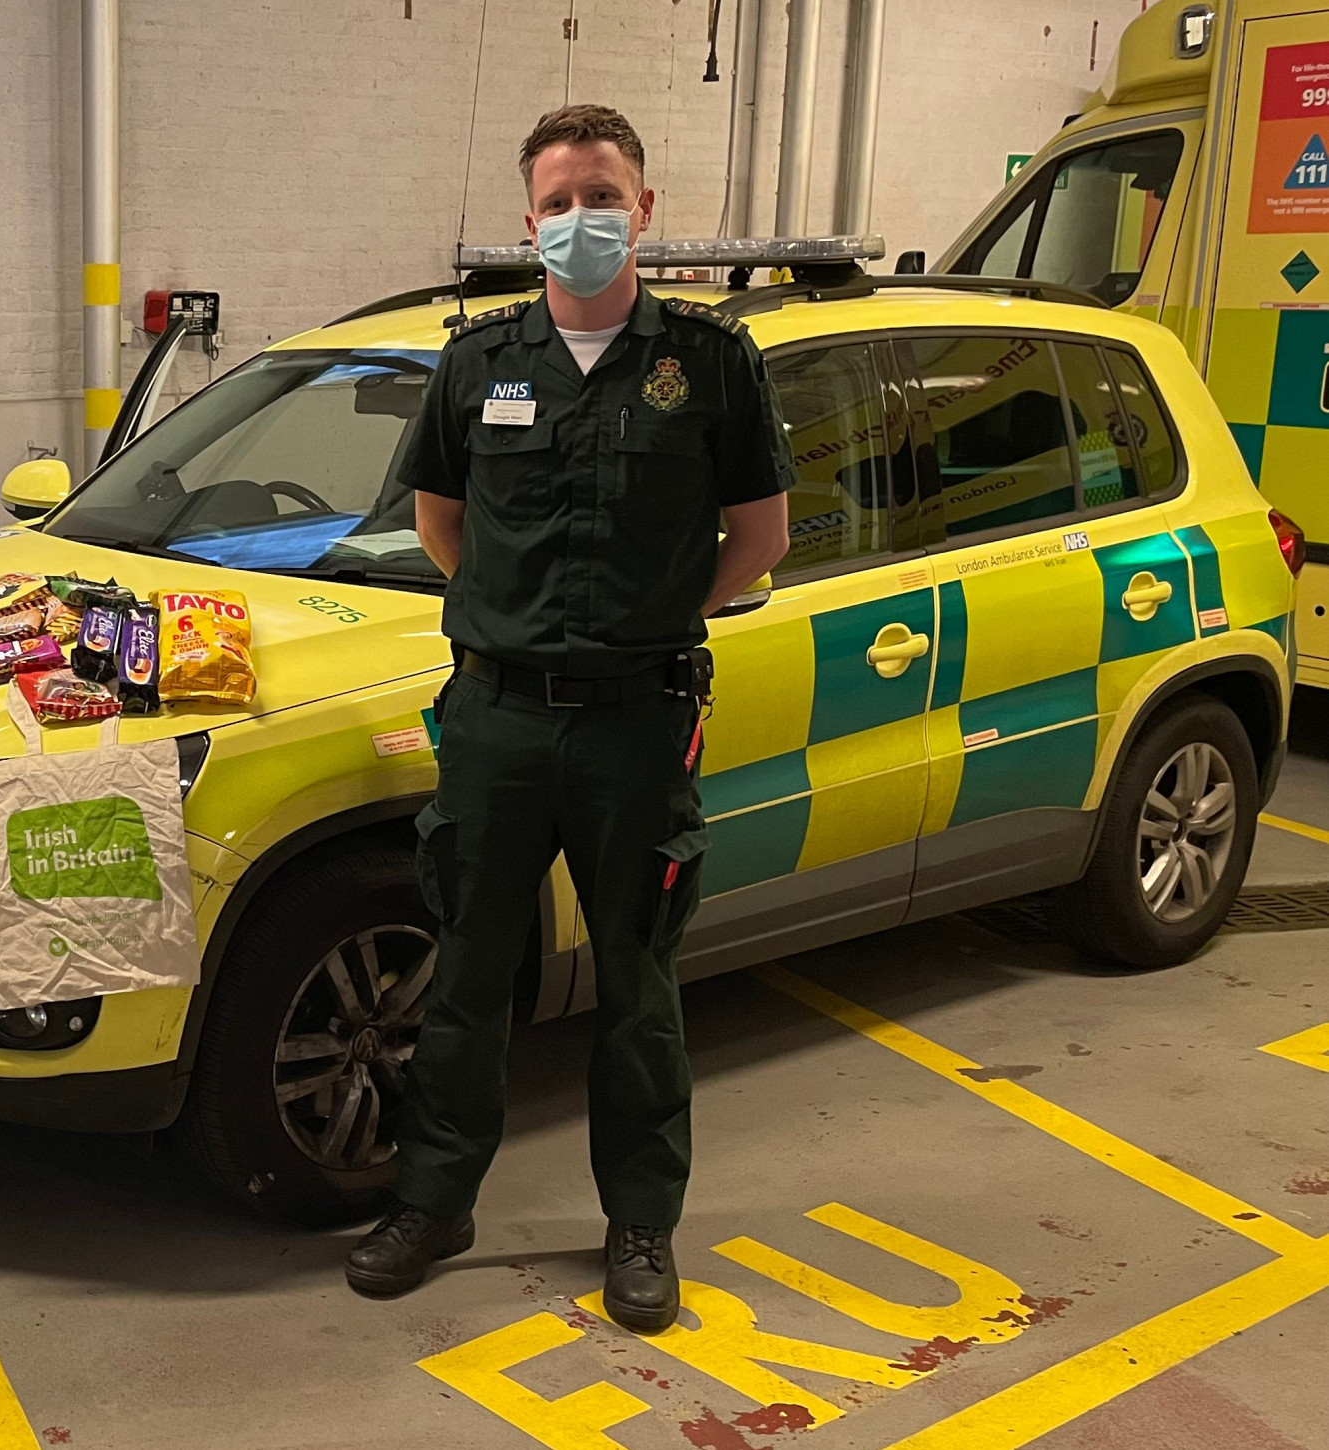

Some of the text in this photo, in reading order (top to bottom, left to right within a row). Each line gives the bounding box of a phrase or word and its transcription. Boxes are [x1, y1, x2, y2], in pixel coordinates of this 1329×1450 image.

[1301, 87, 1329, 107] 99
[1301, 152, 1326, 161] CALL
[1295, 164, 1328, 184] 111
[492, 382, 529, 399] NHS
[956, 532, 1089, 574] London Ambulance Service NHS
[162, 594, 246, 620] TAYTO
[298, 595, 369, 623] 8275
[177, 615, 194, 633] 6
[138, 629, 155, 656] Elite
[172, 630, 202, 641] PACK
[172, 639, 205, 649] CHEESE
[179, 642, 209, 654] ONION
[23, 824, 77, 849] Irish
[27, 843, 136, 875] in Britain
